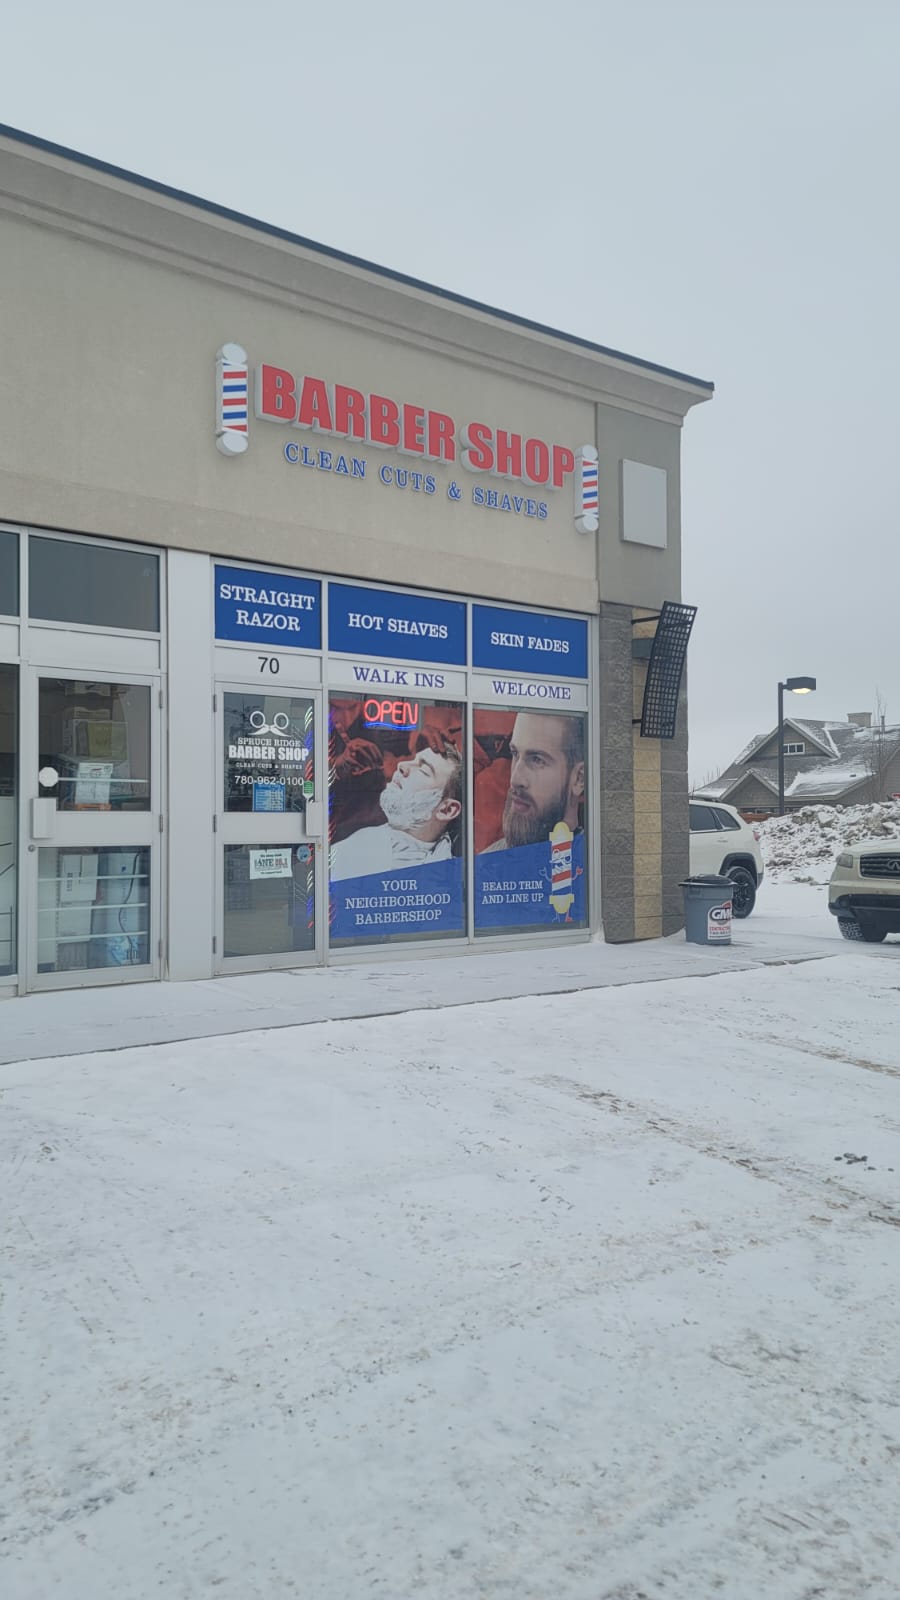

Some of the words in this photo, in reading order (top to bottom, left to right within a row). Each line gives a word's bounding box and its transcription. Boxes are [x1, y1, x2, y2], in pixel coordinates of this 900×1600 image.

[259, 363, 456, 462] BARBER
[466, 421, 575, 488] SHOP
[284, 442, 367, 479] CLEAN
[379, 465, 437, 495] CUTS
[448, 481, 463, 500] &
[472, 486, 549, 520] SHAVES
[219, 583, 316, 611] STRAIGHT
[235, 609, 301, 632] RAZOR
[347, 612, 384, 633] HOT
[387, 619, 449, 640] SHAVES
[490, 631, 524, 649] SKIN
[527, 636, 570, 654] FADES
[257, 656, 280, 675] 70
[352, 665, 409, 686] WALK
[413, 671, 446, 690] INS
[492, 680, 572, 701] WELCOME
[363, 698, 419, 725] OPEN
[237, 737, 272, 746] SPRUCE
[274, 739, 301, 747] RIDGE
[228, 744, 276, 760] BARBER
[277, 747, 310, 761] SHOP
[234, 775, 305, 786] 780-962-0100
[381, 879, 418, 892] YOUR
[482, 881, 517, 892] BEARD
[518, 879, 544, 891] TRIM
[344, 893, 452, 910] NEIGHBORHOOD
[481, 894, 504, 905] AND
[505, 893, 529, 904] LINE
[531, 892, 544, 903] UP
[355, 909, 442, 926] BARBERSHOP
